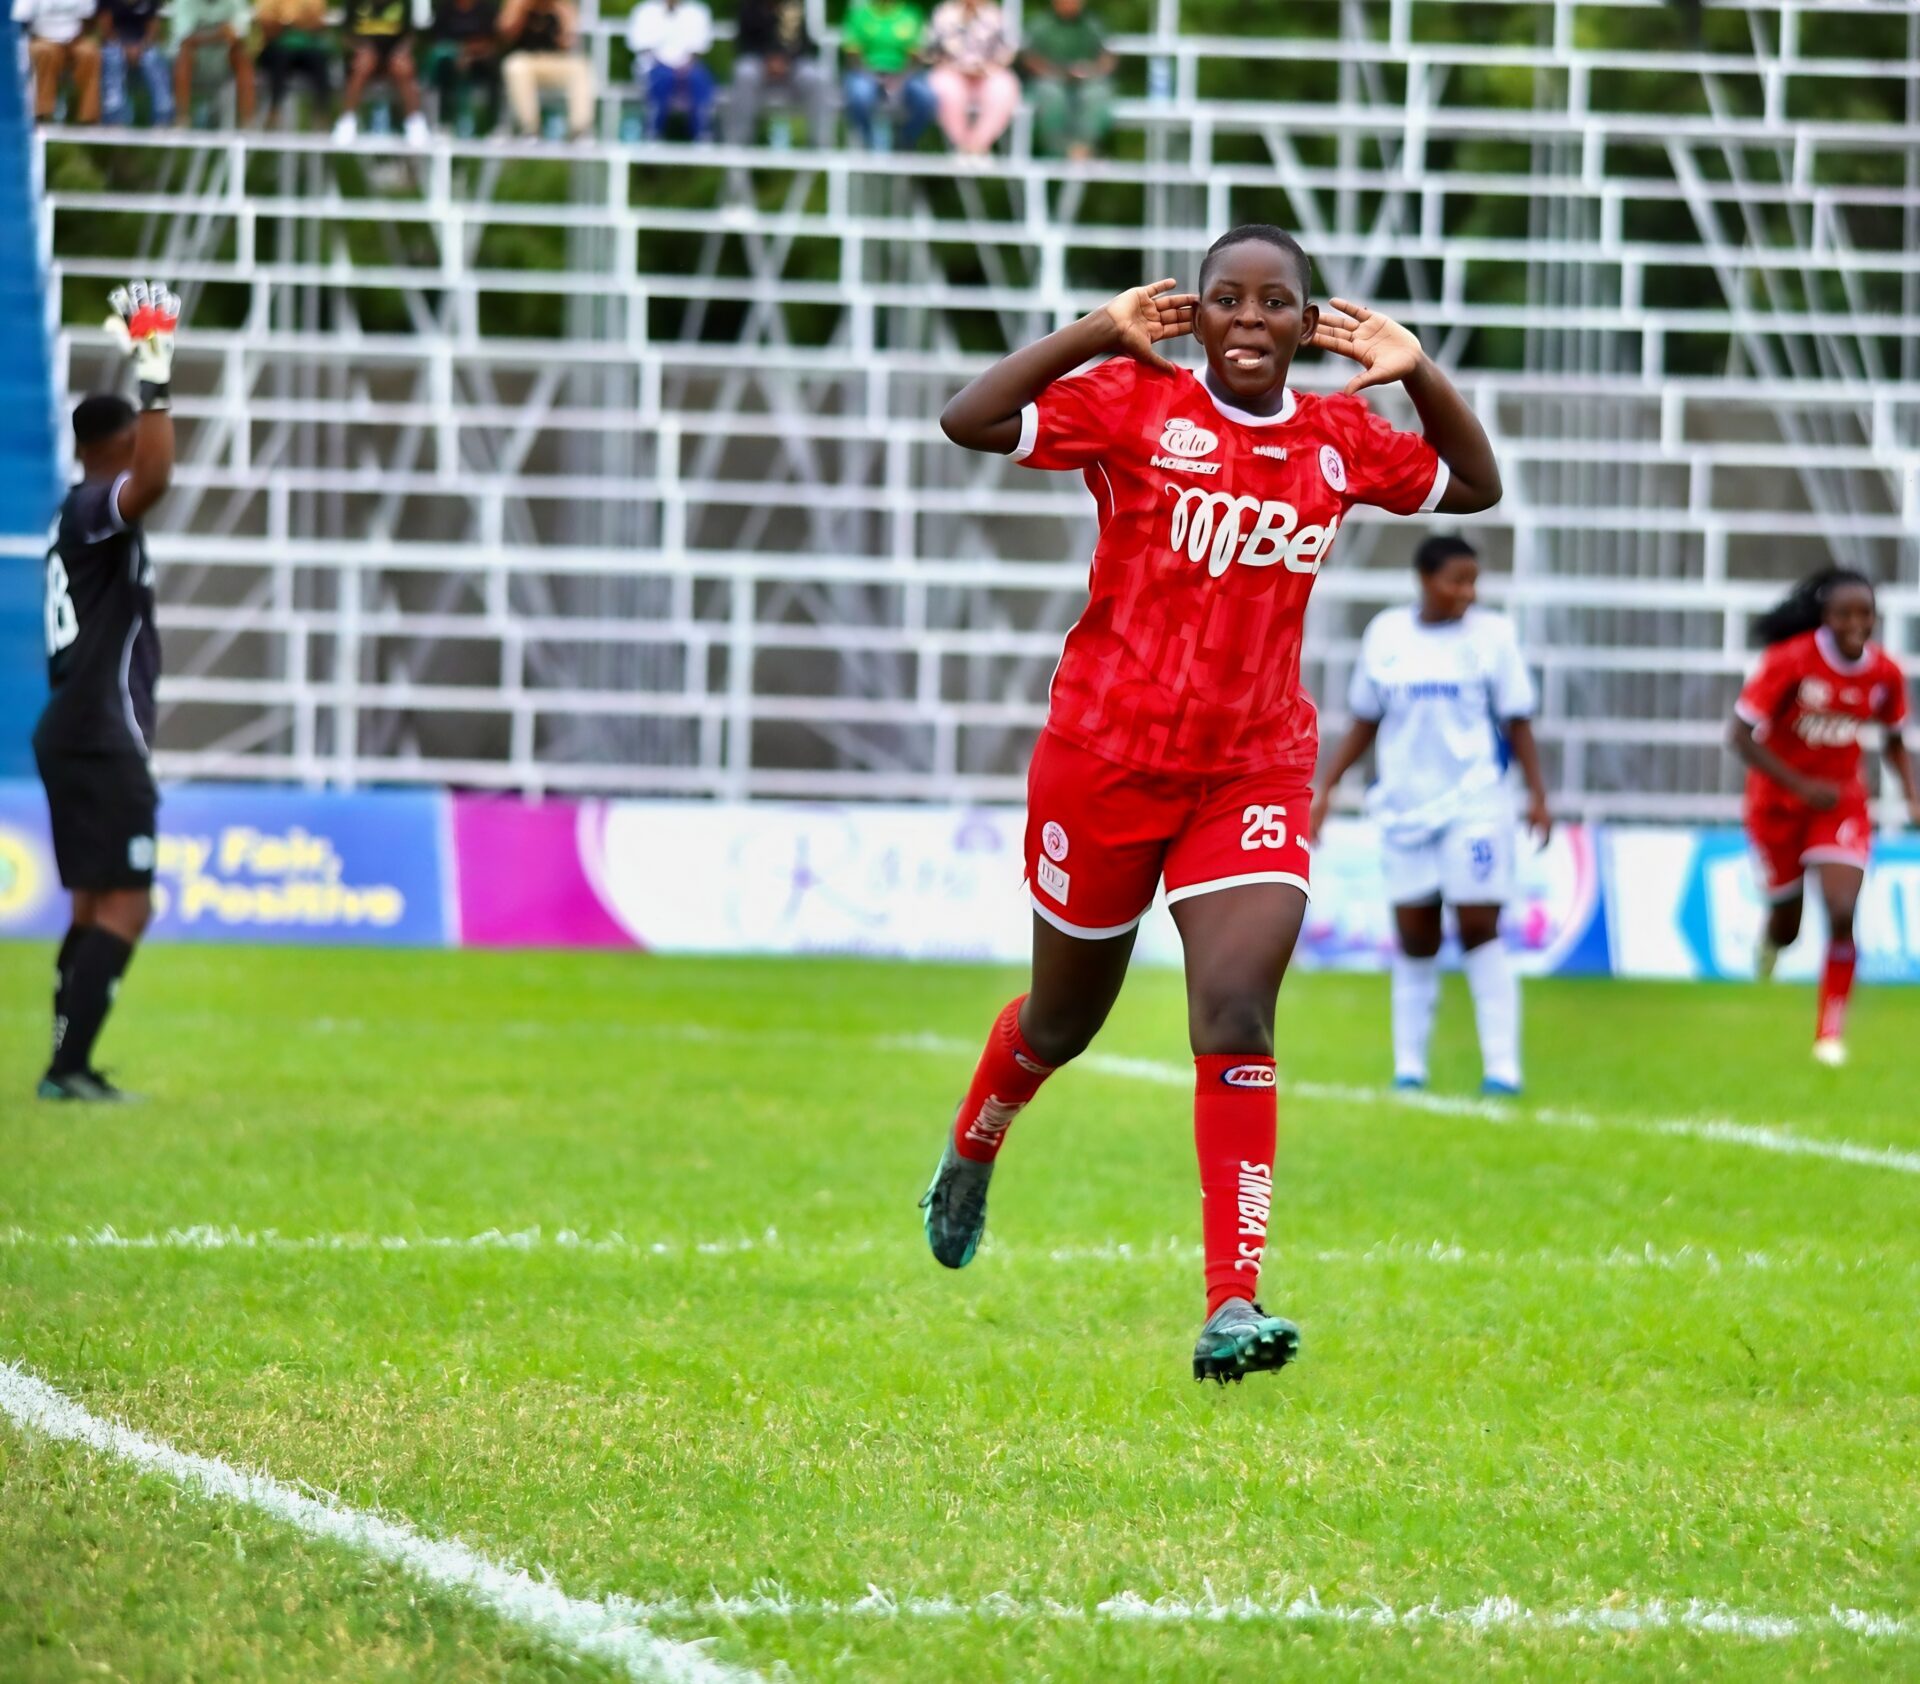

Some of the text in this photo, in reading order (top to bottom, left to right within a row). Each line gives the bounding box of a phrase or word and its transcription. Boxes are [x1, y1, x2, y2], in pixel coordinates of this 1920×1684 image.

[1165, 482, 1338, 578] M-Bet
[1241, 805, 1287, 851] 25
[181, 876, 404, 926] Positive
[1234, 1160, 1273, 1278] SIMBA SC
